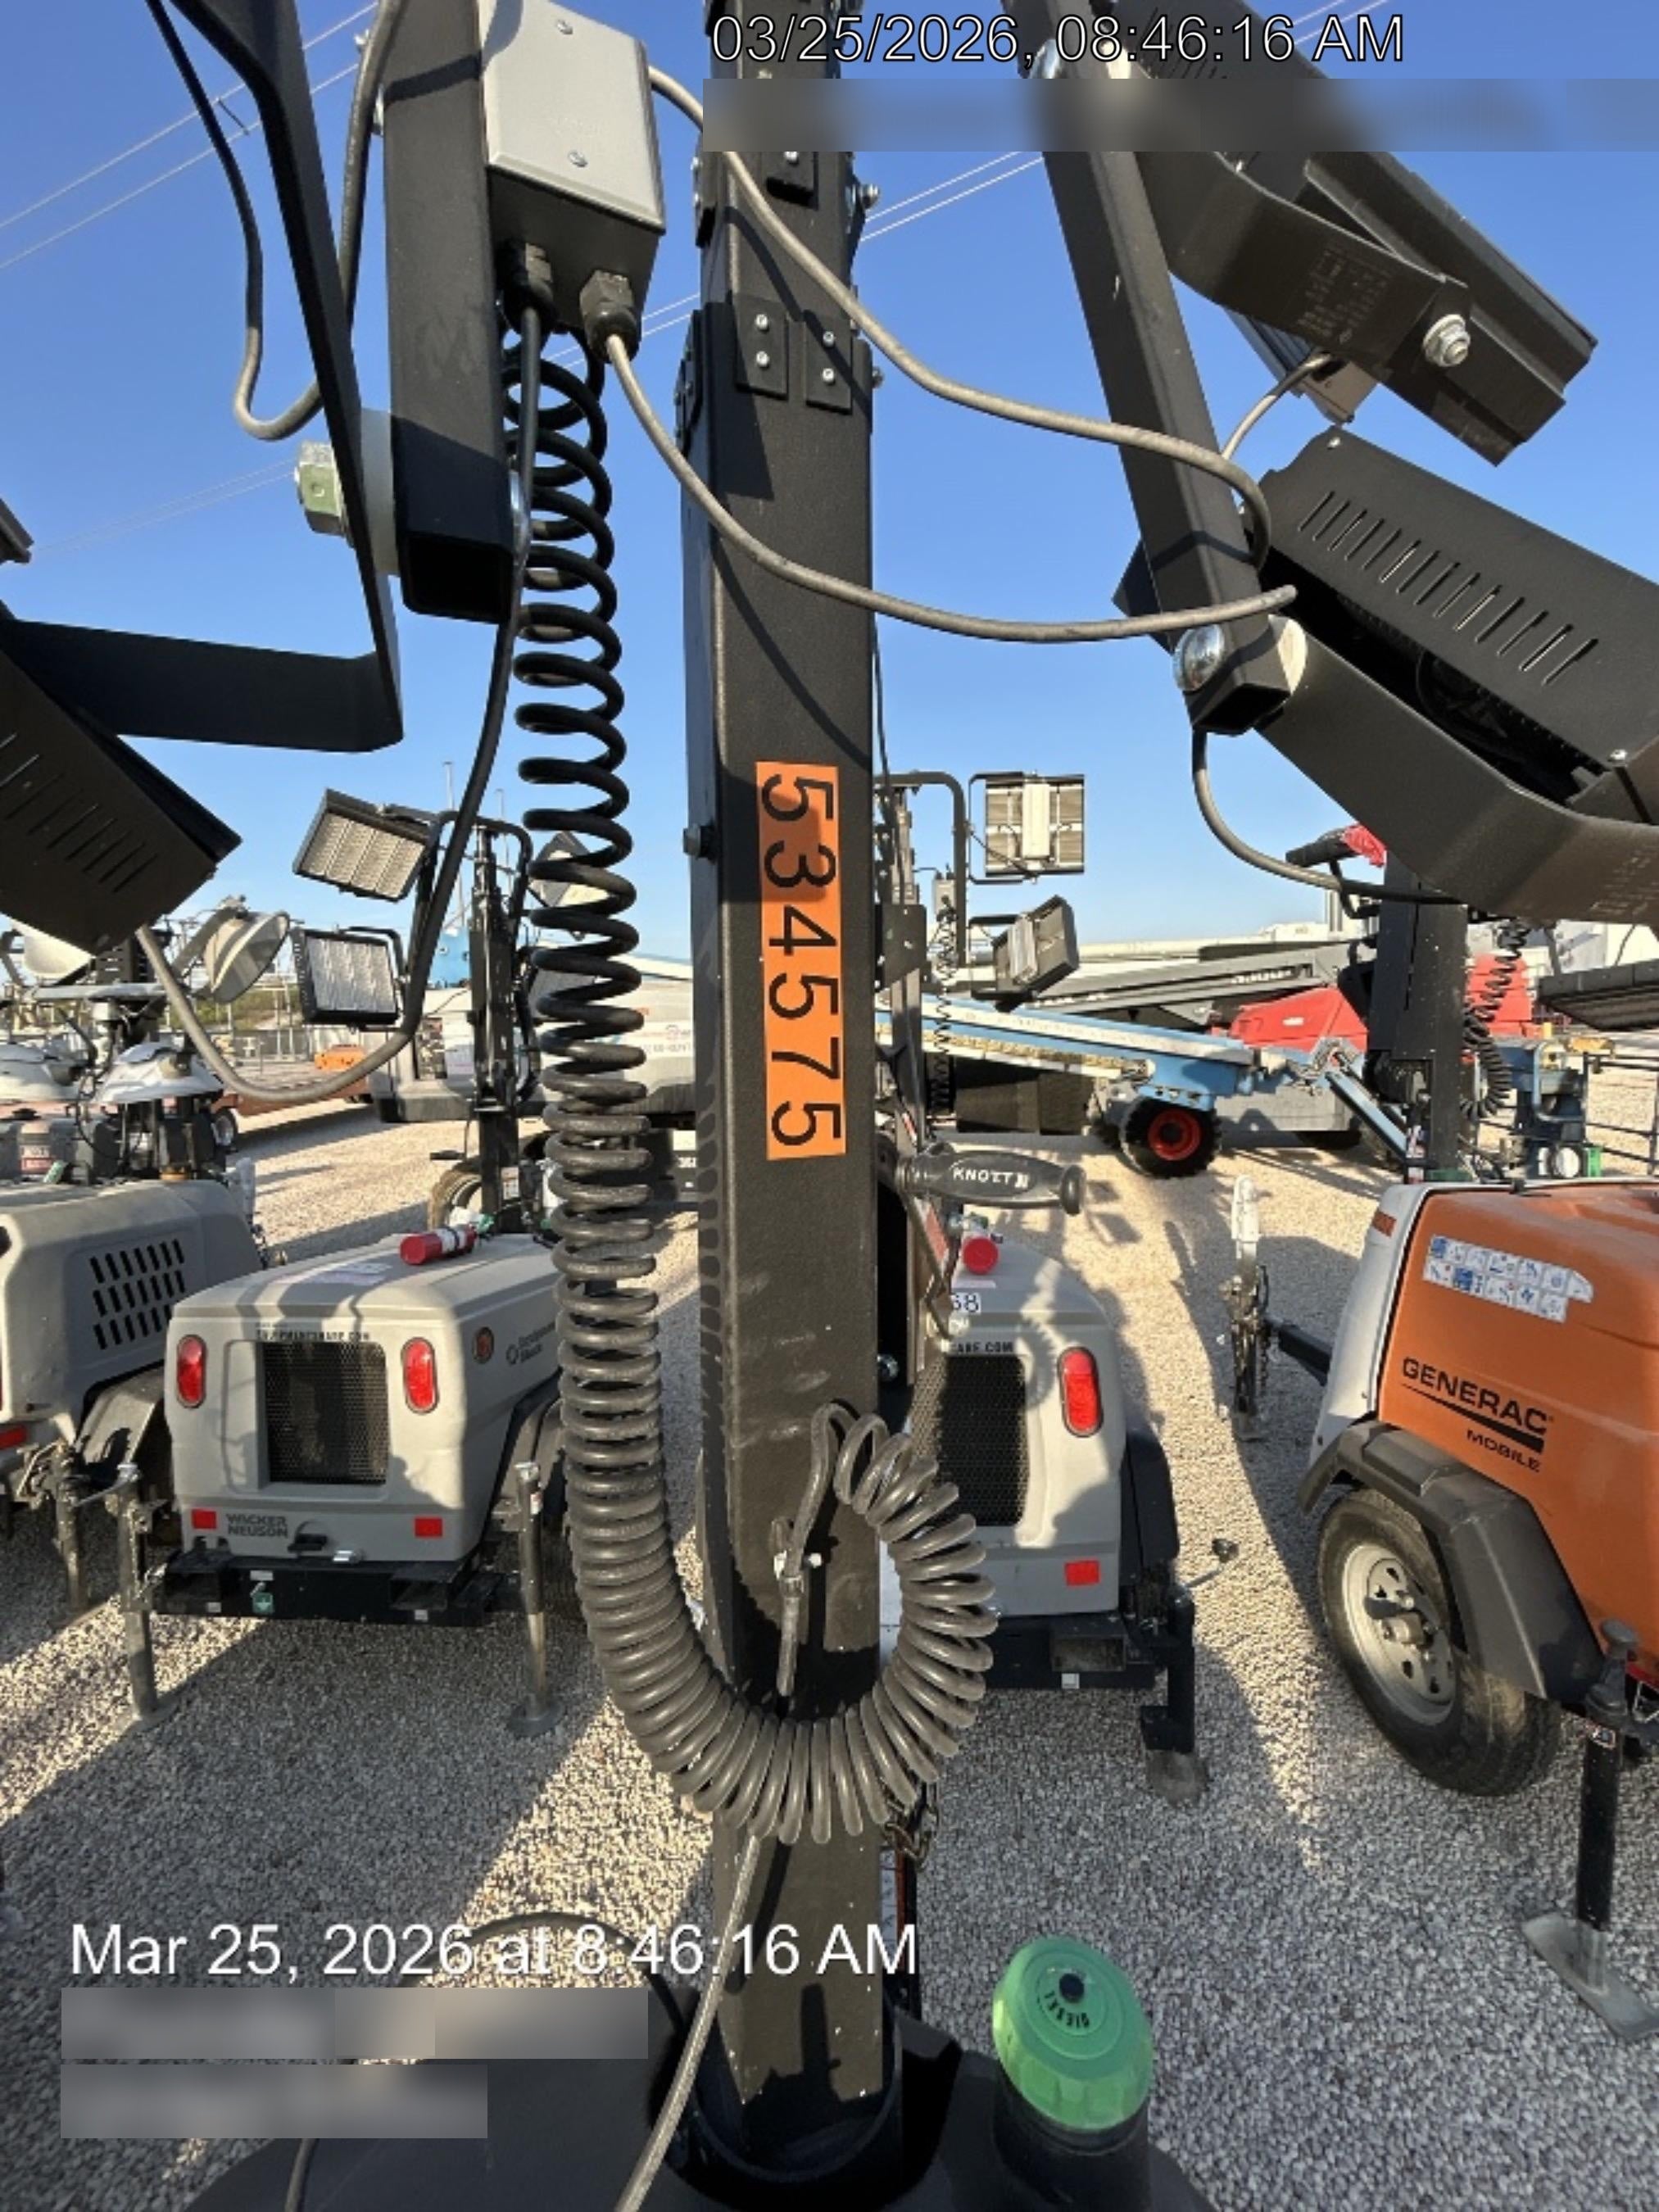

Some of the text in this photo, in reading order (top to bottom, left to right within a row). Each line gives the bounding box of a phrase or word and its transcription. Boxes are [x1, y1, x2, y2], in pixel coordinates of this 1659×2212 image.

[761, 773, 842, 1146] 534575
[952, 1167, 1014, 1185] KNOTT
[1402, 1356, 1548, 1436] GENERAC
[1466, 1428, 1542, 1473] MOBILE
